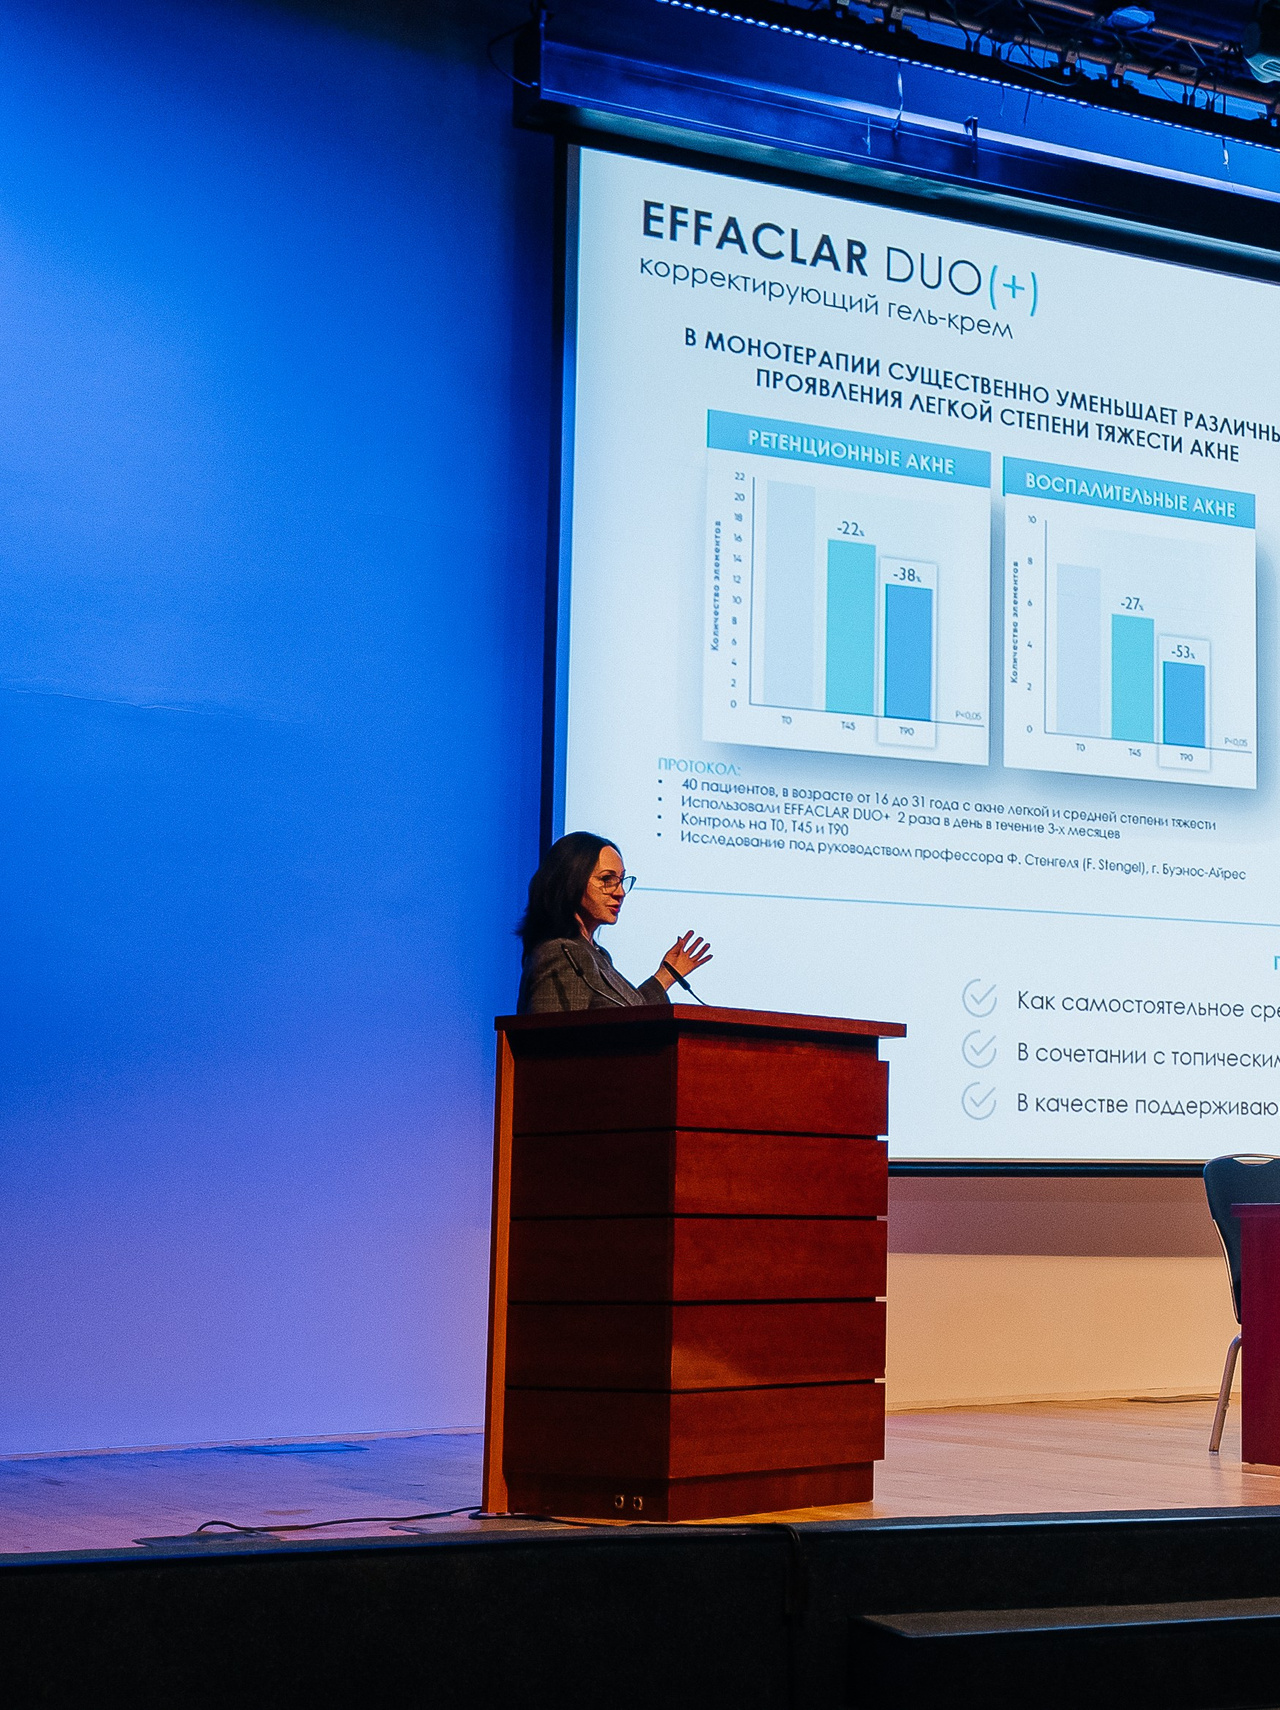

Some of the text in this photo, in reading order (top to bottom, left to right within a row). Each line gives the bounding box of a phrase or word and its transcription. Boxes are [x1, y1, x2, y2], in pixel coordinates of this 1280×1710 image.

[643, 199, 1037, 317] EFFACLAR DUO(+)
[640, 257, 1013, 339] корректирующий гель-крем
[685, 327, 696, 346] В
[704, 331, 879, 377] МОНОТЕРАПИИ
[888, 362, 1049, 404] СУЩЕСТВЕННО
[1056, 389, 1177, 425] УМЕНЬШАЕТ
[756, 368, 1239, 462] ПРОЯВЛЕНИЯ ЛЕГКОЙ СТЕПЕНИ ТЯЖЕСТИ АКНЕ
[748, 429, 953, 474] РЕТЕНЦИОННЫЕ АКНЕ
[1026, 472, 1235, 518] ВОСПАЛИТЕЛЬНЫЕ АКНЕ
[836, 521, 865, 537] -22%
[892, 567, 922, 583] -38%
[1120, 597, 1144, 611] -27%
[1010, 621, 1018, 684] Количество
[1171, 645, 1196, 660] -53%
[841, 721, 856, 731] T45
[899, 726, 915, 736] T90
[1128, 748, 1142, 757] T45
[1179, 753, 1193, 762] T90
[658, 757, 741, 776] ПРОТОКОЛ:
[681, 777, 698, 791] 40
[701, 781, 778, 798] пациентов,
[782, 787, 788, 797] в
[792, 788, 853, 802] возрасте
[857, 793, 870, 803] от
[875, 792, 888, 805] 16
[891, 796, 908, 807] до
[911, 795, 924, 807] 31
[929, 798, 959, 811] года
[962, 801, 970, 811] с
[974, 802, 1004, 814] акне
[1007, 805, 1049, 817] легкой
[1052, 809, 1060, 818] и
[1063, 809, 1116, 823] средней
[1120, 814, 1168, 826] степени
[681, 795, 1120, 840] Использовали EFFACLAR DUO+ 2 раза в день в течение 3-х месяцев
[681, 812, 745, 829] Контроль
[749, 819, 767, 830] на
[815, 824, 824, 834] и
[680, 830, 1246, 881] Исследование под руководством профессора Ф. Стенгеля (F. Stengel), г. Буэнос-Айрес
[1018, 990, 1055, 1010] Как
[1061, 996, 1244, 1017] самостоятельное
[1018, 1042, 1029, 1061] В
[1035, 1047, 1146, 1064] сочетании
[1153, 1050, 1165, 1065] с
[1017, 1093, 1028, 1112] В
[1035, 1097, 1128, 1113] качестве
